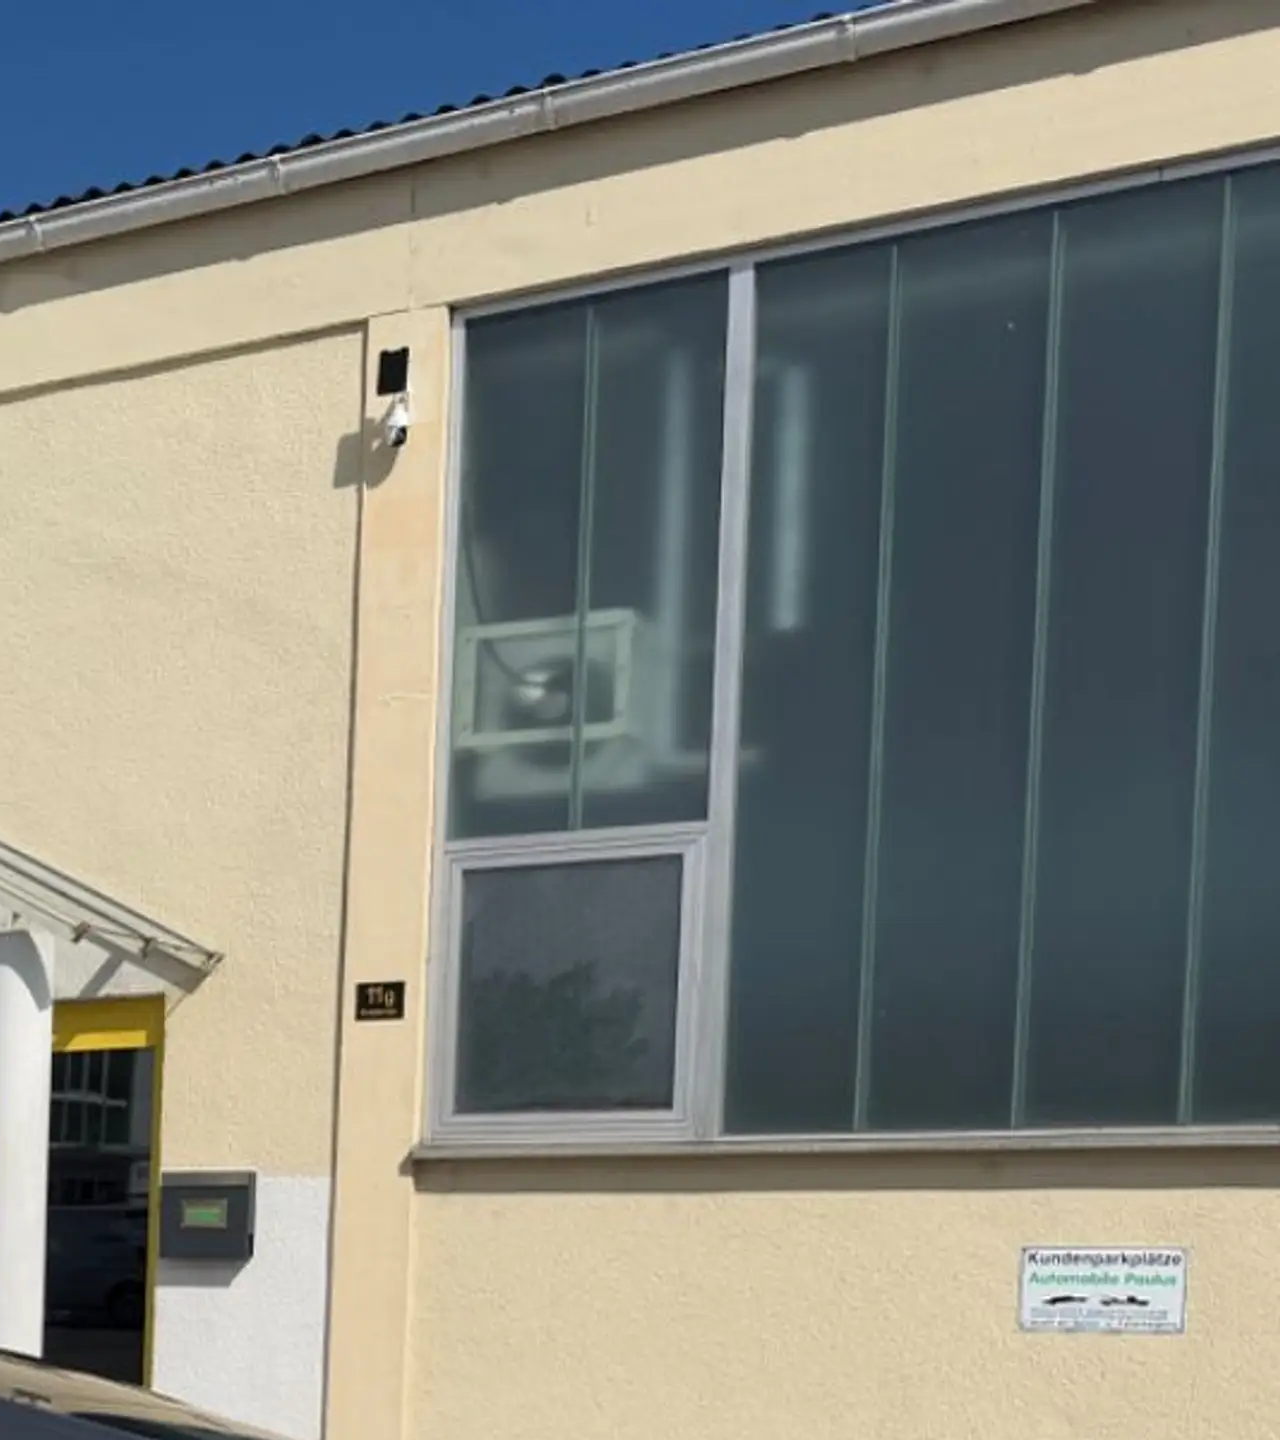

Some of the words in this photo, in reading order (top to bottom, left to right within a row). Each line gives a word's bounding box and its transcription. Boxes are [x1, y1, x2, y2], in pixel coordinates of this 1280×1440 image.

[1027, 1252, 1183, 1267] Kundenparkplätze
[1029, 1271, 1121, 1287] Automobile
[1124, 1271, 1177, 1288] Paulus
